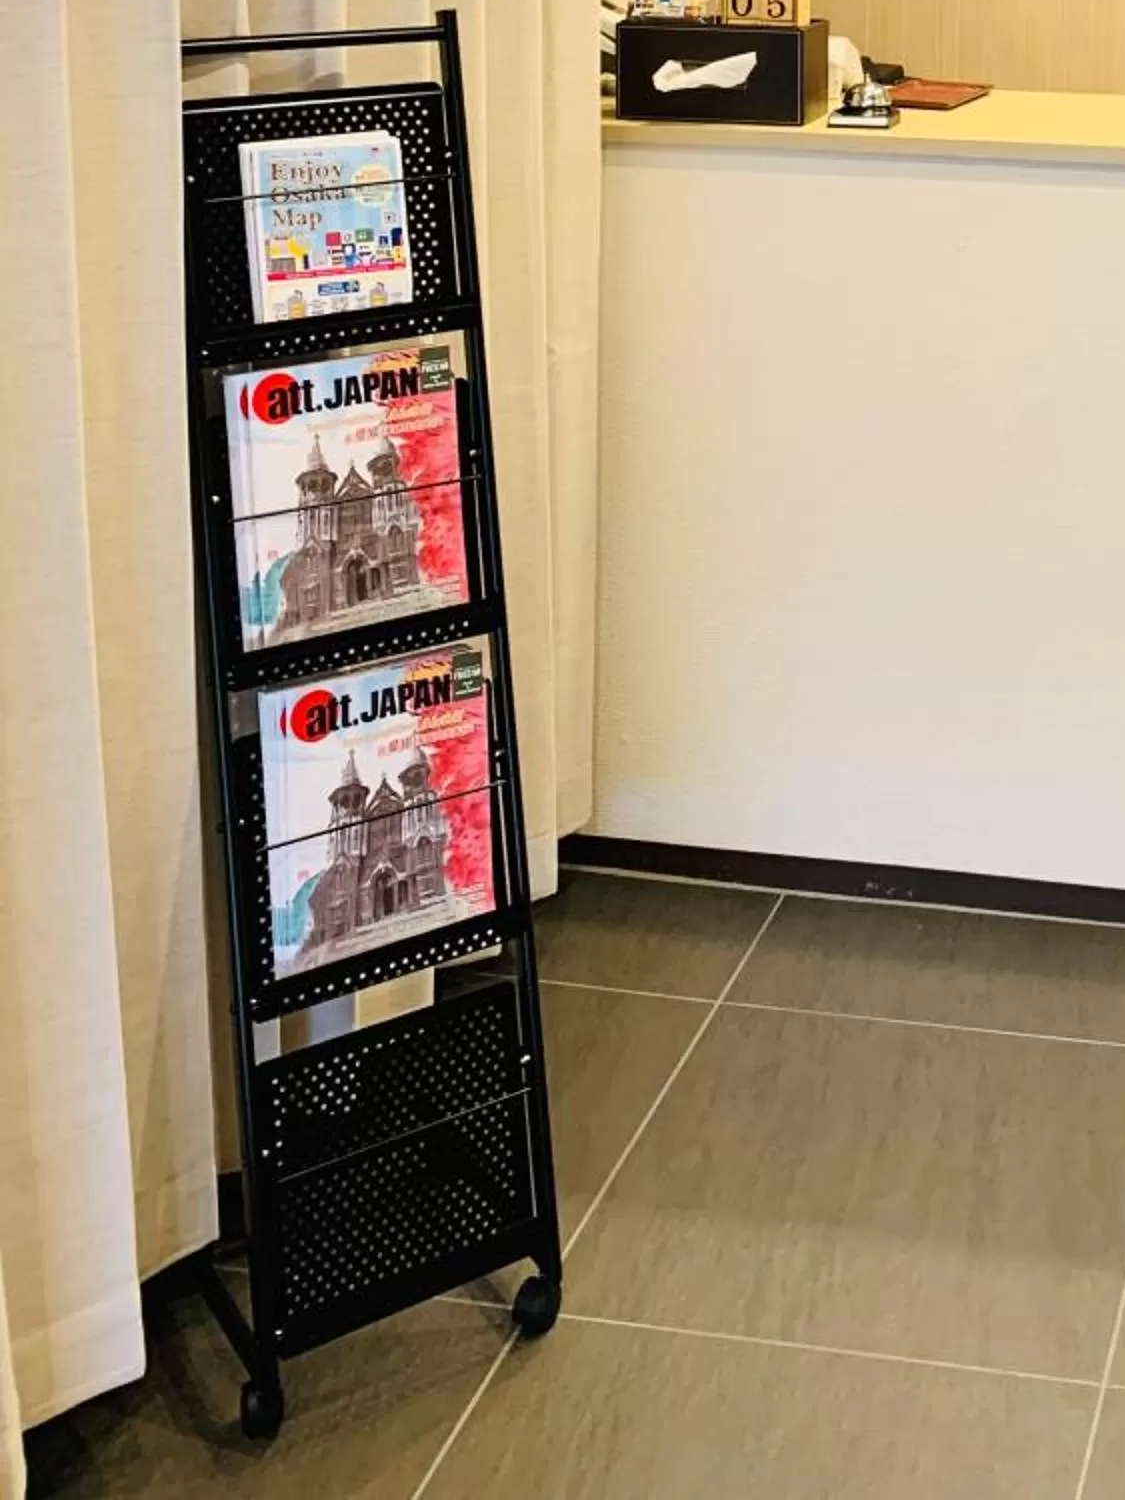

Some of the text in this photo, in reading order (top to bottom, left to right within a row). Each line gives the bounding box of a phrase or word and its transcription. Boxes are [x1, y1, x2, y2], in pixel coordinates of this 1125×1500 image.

[271, 160, 343, 185] Enjoy
[271, 184, 347, 204] Osaka
[272, 207, 322, 230] Map
[267, 366, 419, 420] att.JAPAN
[305, 673, 452, 738] att.JAPAN
